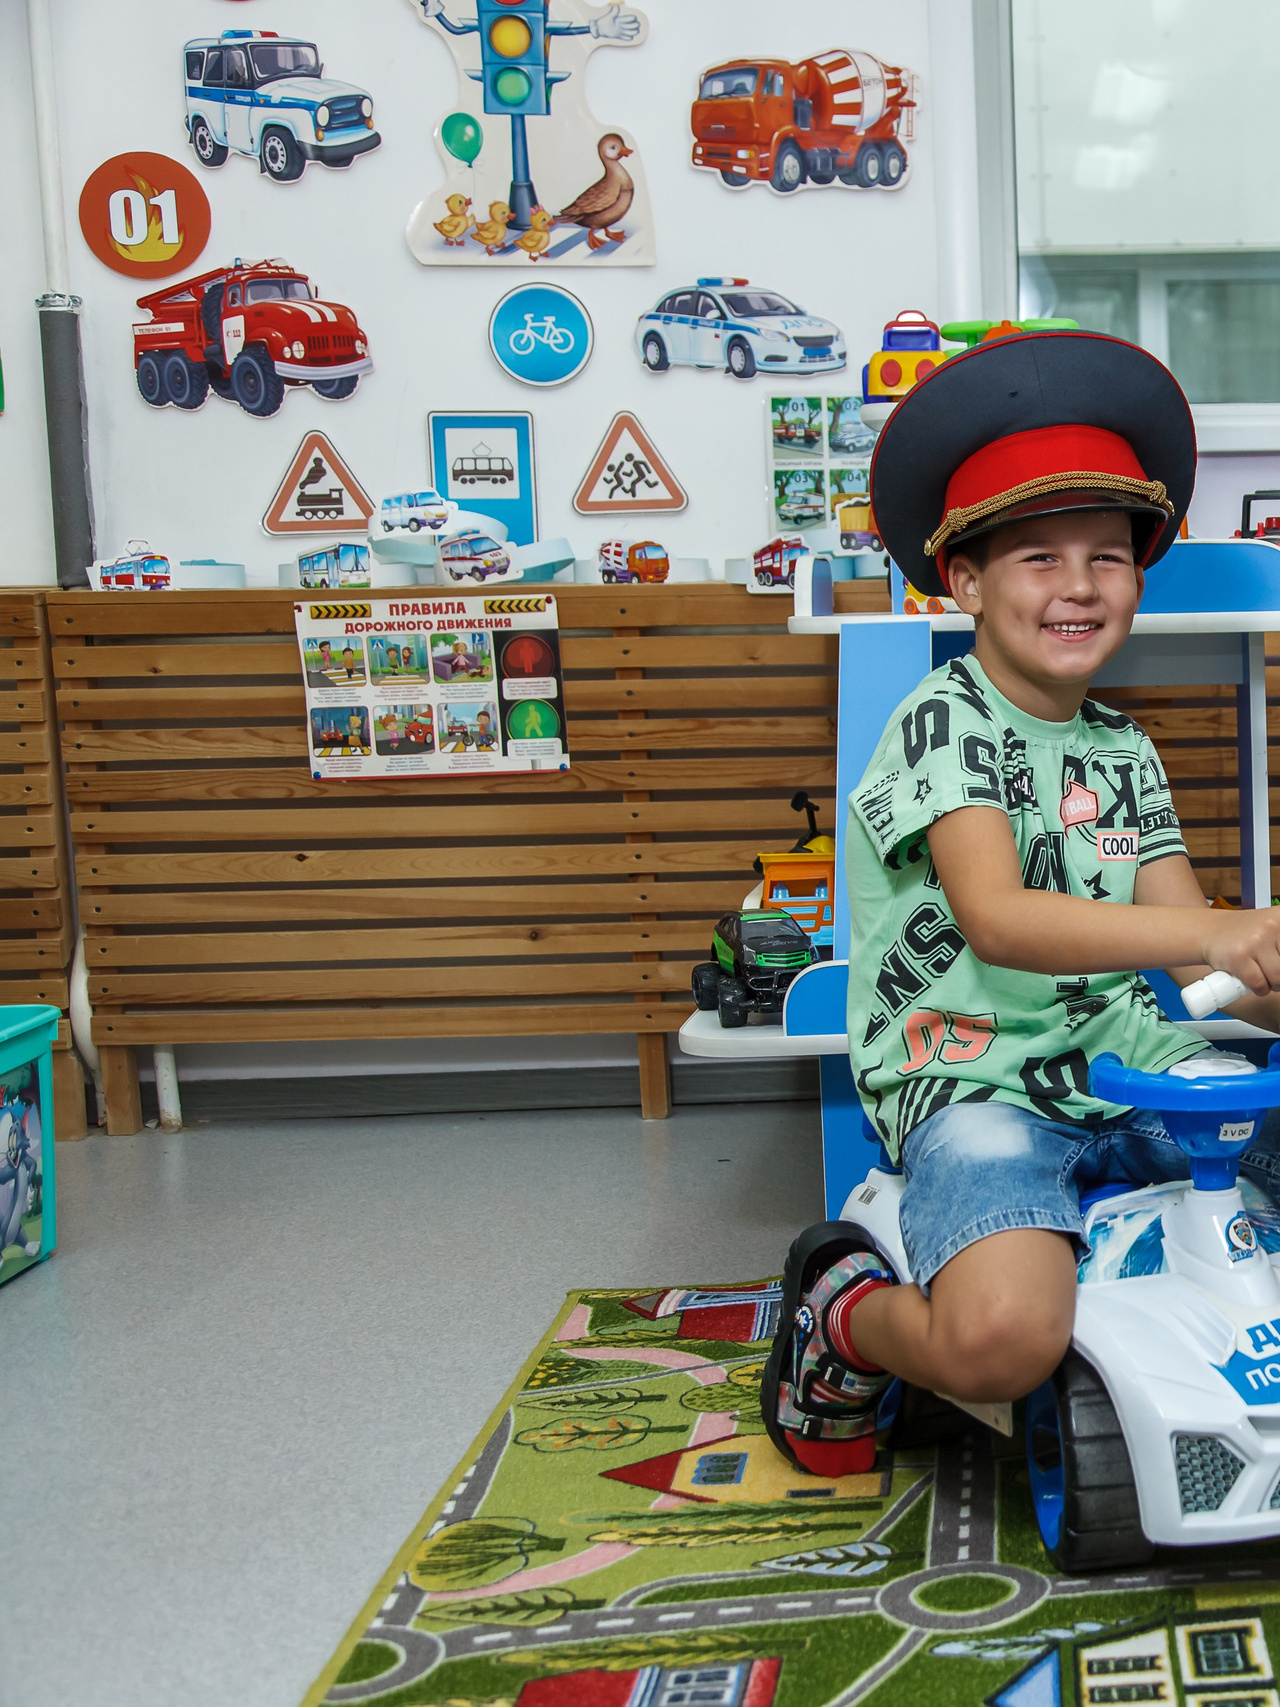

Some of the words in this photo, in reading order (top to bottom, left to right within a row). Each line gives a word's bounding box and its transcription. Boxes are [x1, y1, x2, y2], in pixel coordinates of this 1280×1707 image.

[108, 189, 179, 246] 01
[780, 318, 824, 330] ДПС
[791, 401, 805, 412] 01
[845, 400, 859, 411] 02
[794, 473, 808, 483] 03
[847, 472, 861, 482] 04
[389, 602, 466, 616] ПРАВИЛА
[345, 619, 433, 634] ДОРОЖНОГО
[436, 618, 512, 631] ДВИЖЕНИЯ
[1102, 837, 1137, 856] COOL
[1230, 1129, 1236, 1137] V
[1238, 1128, 1249, 1136] DC
